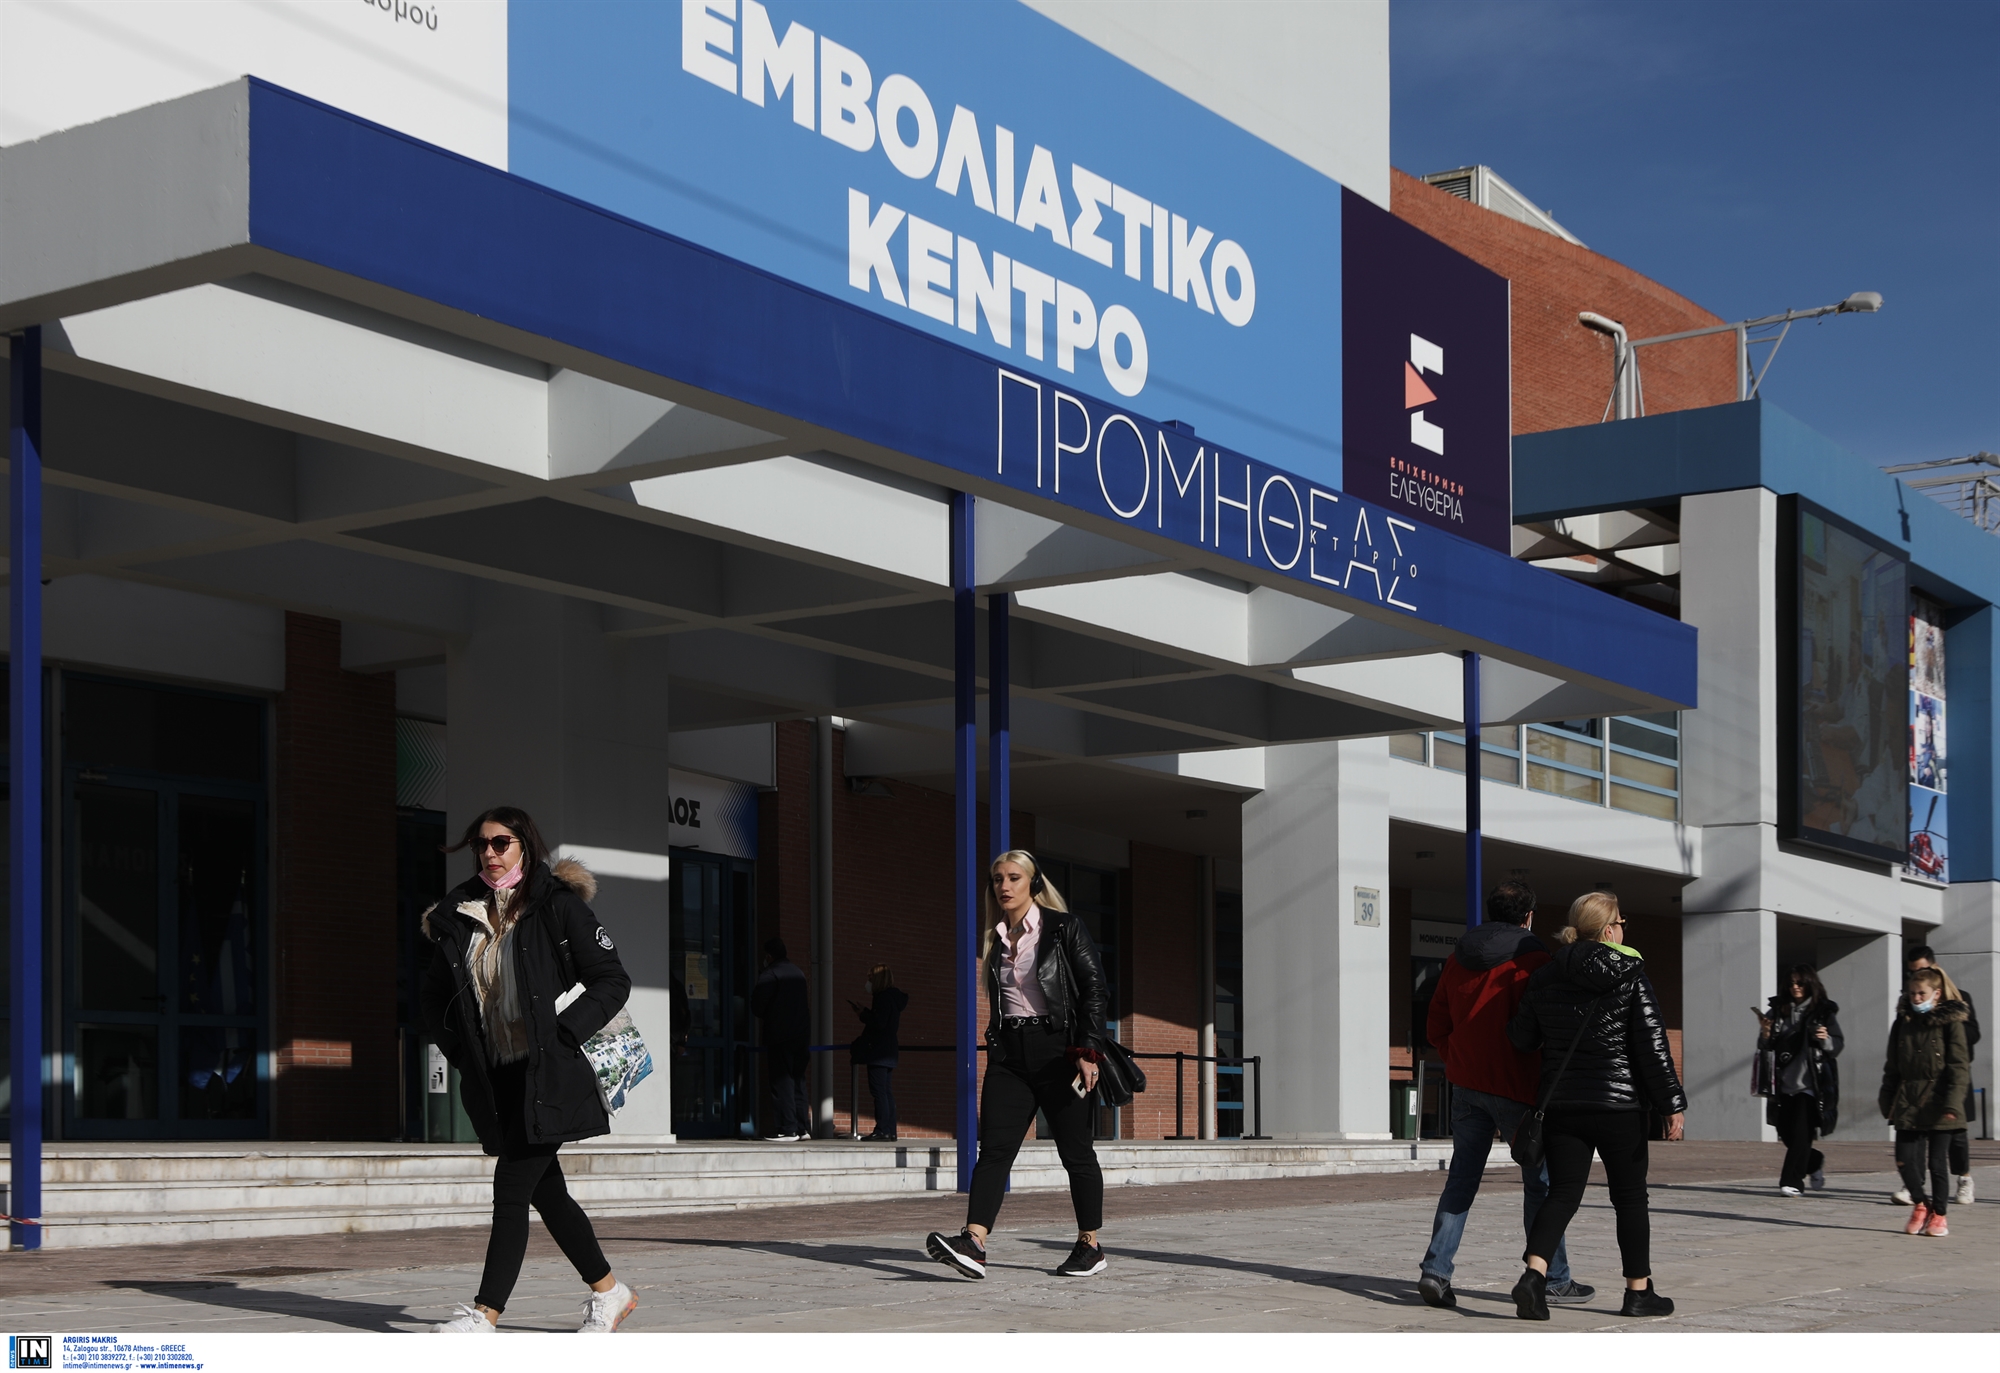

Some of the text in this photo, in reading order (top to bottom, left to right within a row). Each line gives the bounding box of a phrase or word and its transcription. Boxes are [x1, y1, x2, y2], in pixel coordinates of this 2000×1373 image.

[682, 0, 1256, 327] ΕΜΒΟΛΙΑΣΤΙΚΟ
[848, 187, 1148, 397] ΚΕΝΤΡΟ
[997, 368, 1418, 612] ΠΡΟΜΗΘΕΑΣ
[1390, 456, 1464, 497] ΕΠΙΧΕΙΡΗΣΗ
[1390, 472, 1464, 524] ΕΛΕΥΘΕΡΙΑ
[1309, 529, 1418, 579] ΚΤΙΡΙΟ
[1361, 902, 1374, 922] 39
[1419, 933, 1460, 946] ΜΟΝΟΝ ΕΞΟ
